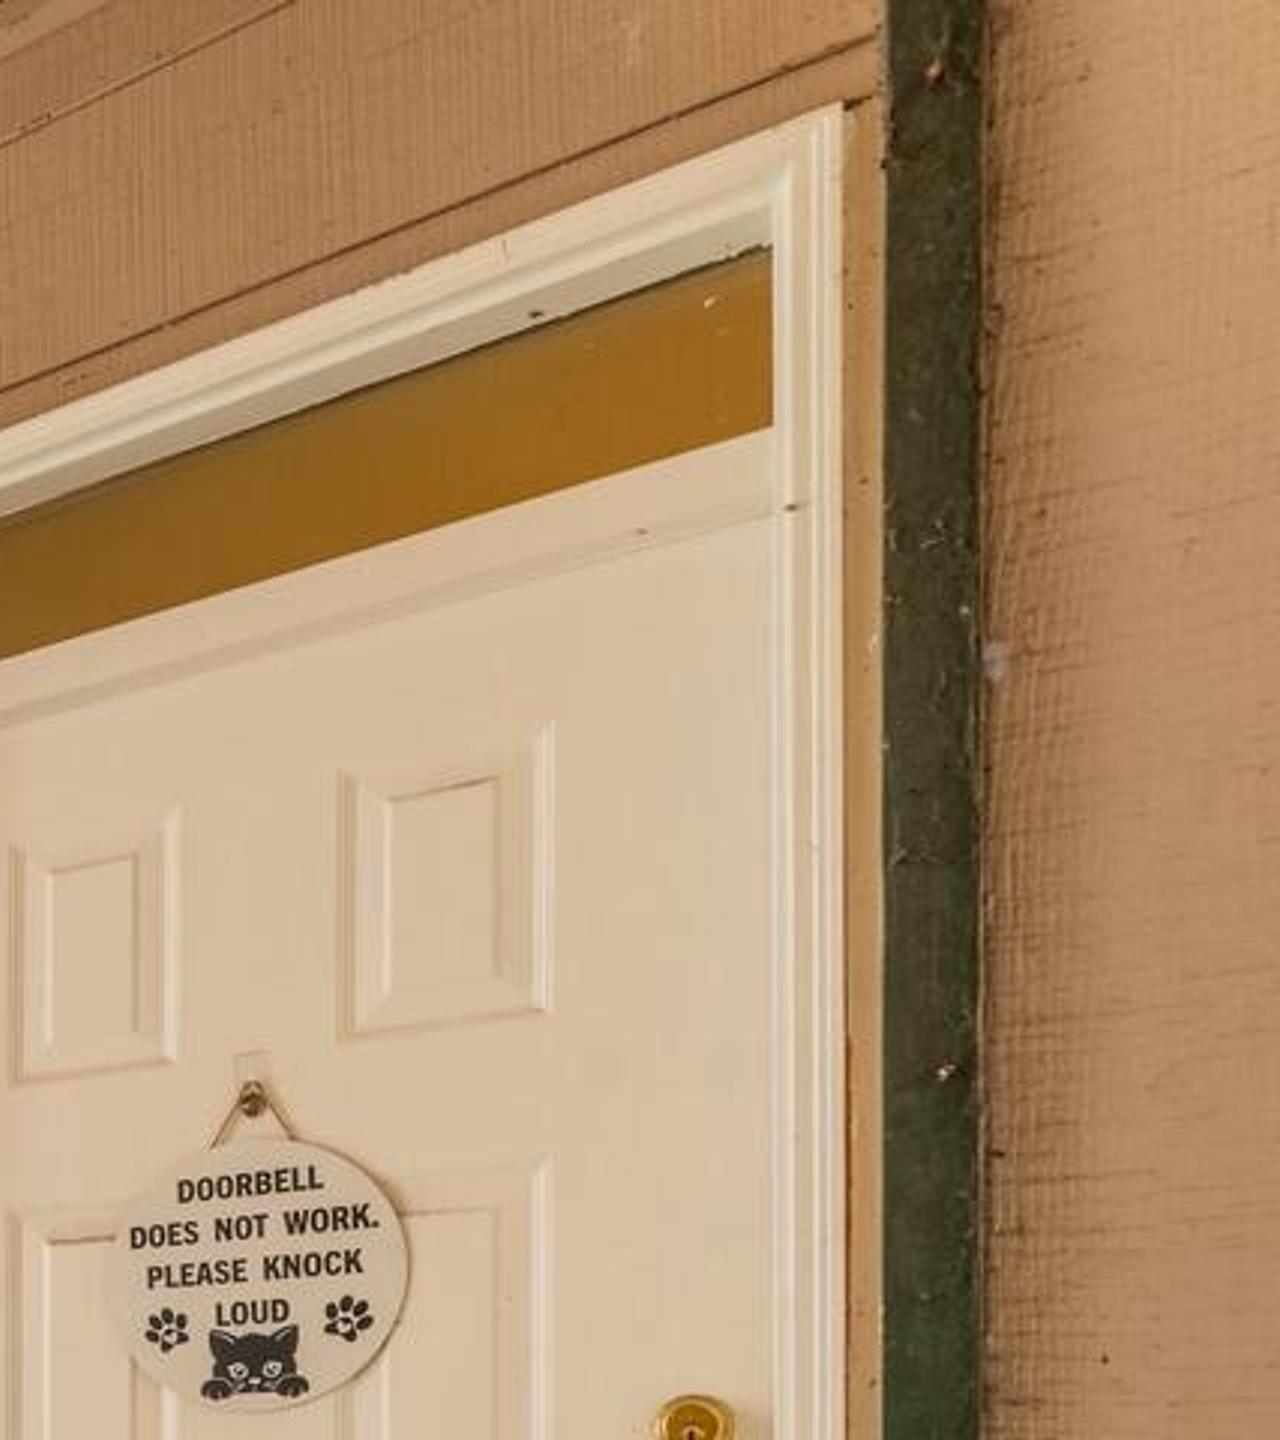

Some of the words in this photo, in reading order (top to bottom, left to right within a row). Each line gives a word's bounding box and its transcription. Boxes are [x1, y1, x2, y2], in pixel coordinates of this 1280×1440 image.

[177, 1165, 324, 1203] DOORBELL
[130, 1221, 199, 1249] DOES
[214, 1214, 269, 1242] NOT
[283, 1203, 379, 1235] WORK.
[147, 1258, 249, 1289] PLEASE
[263, 1248, 363, 1281] KNOCK
[216, 1299, 290, 1327] LOUD
